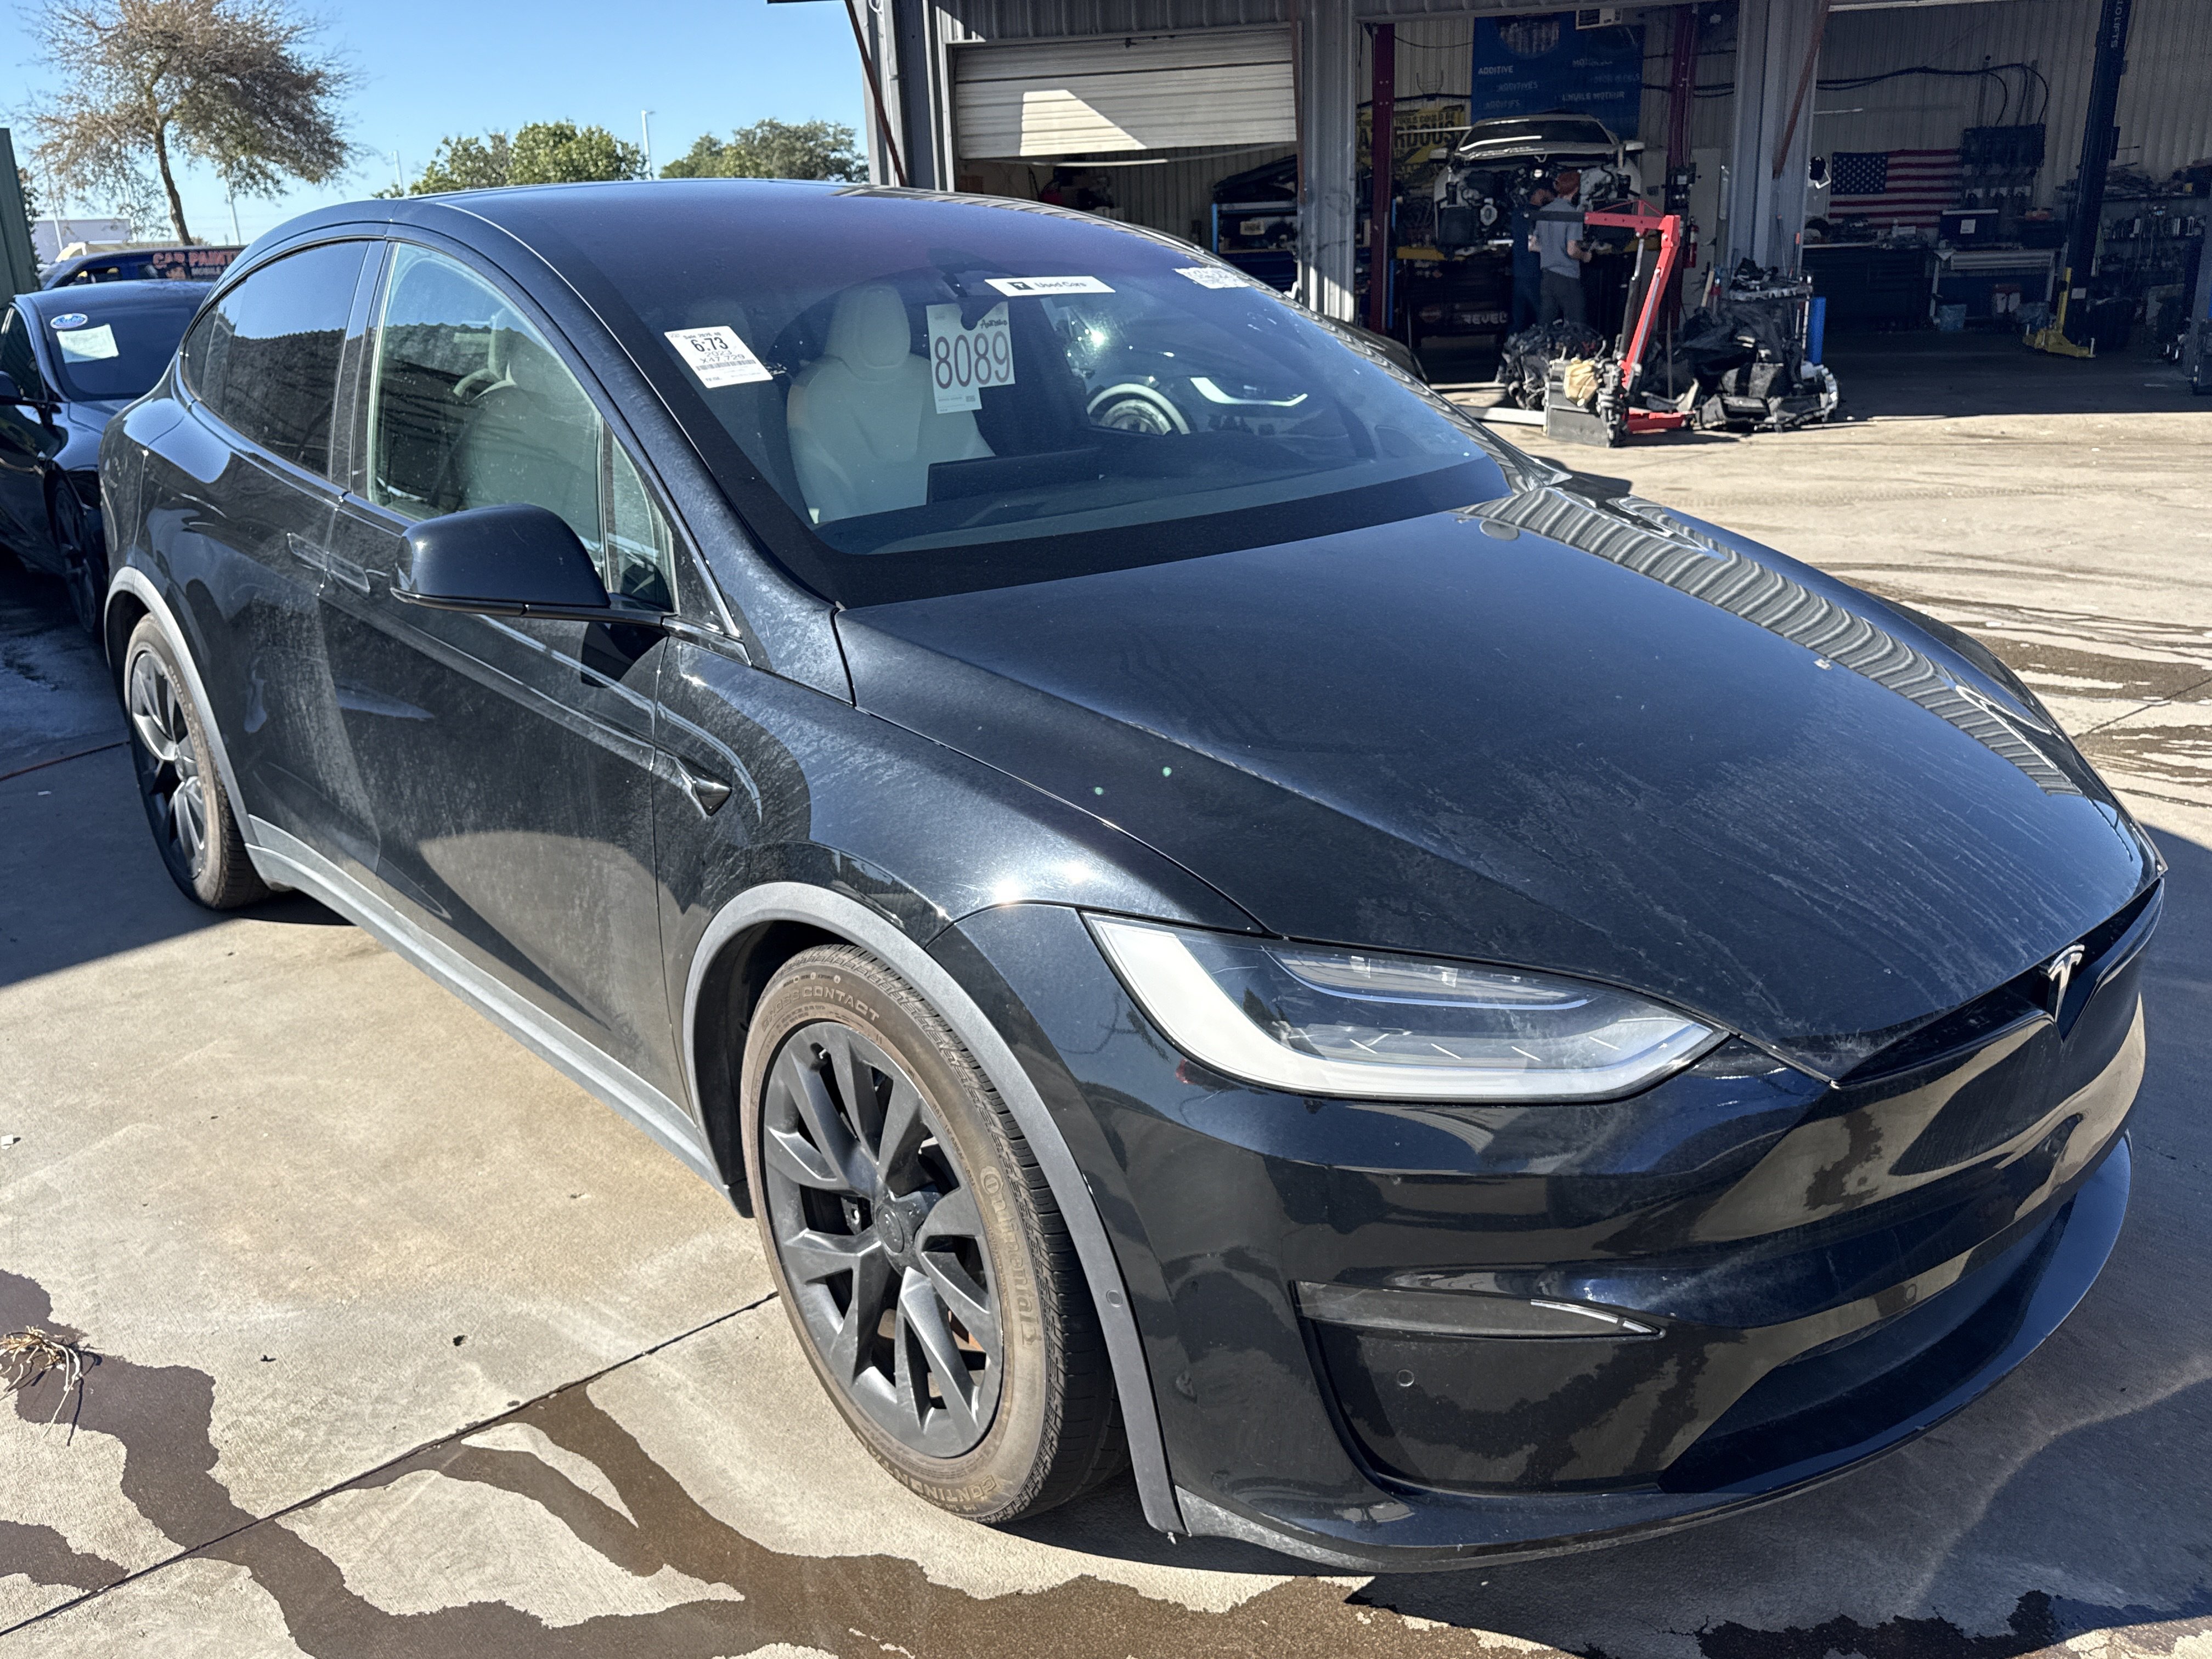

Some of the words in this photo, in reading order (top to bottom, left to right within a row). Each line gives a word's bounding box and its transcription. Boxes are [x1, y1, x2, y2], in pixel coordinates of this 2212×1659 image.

[1477, 65, 1514, 75] ADDITIVE
[153, 252, 185, 269] CAR
[691, 337, 729, 352] 6:73
[934, 331, 1010, 390] 8089
